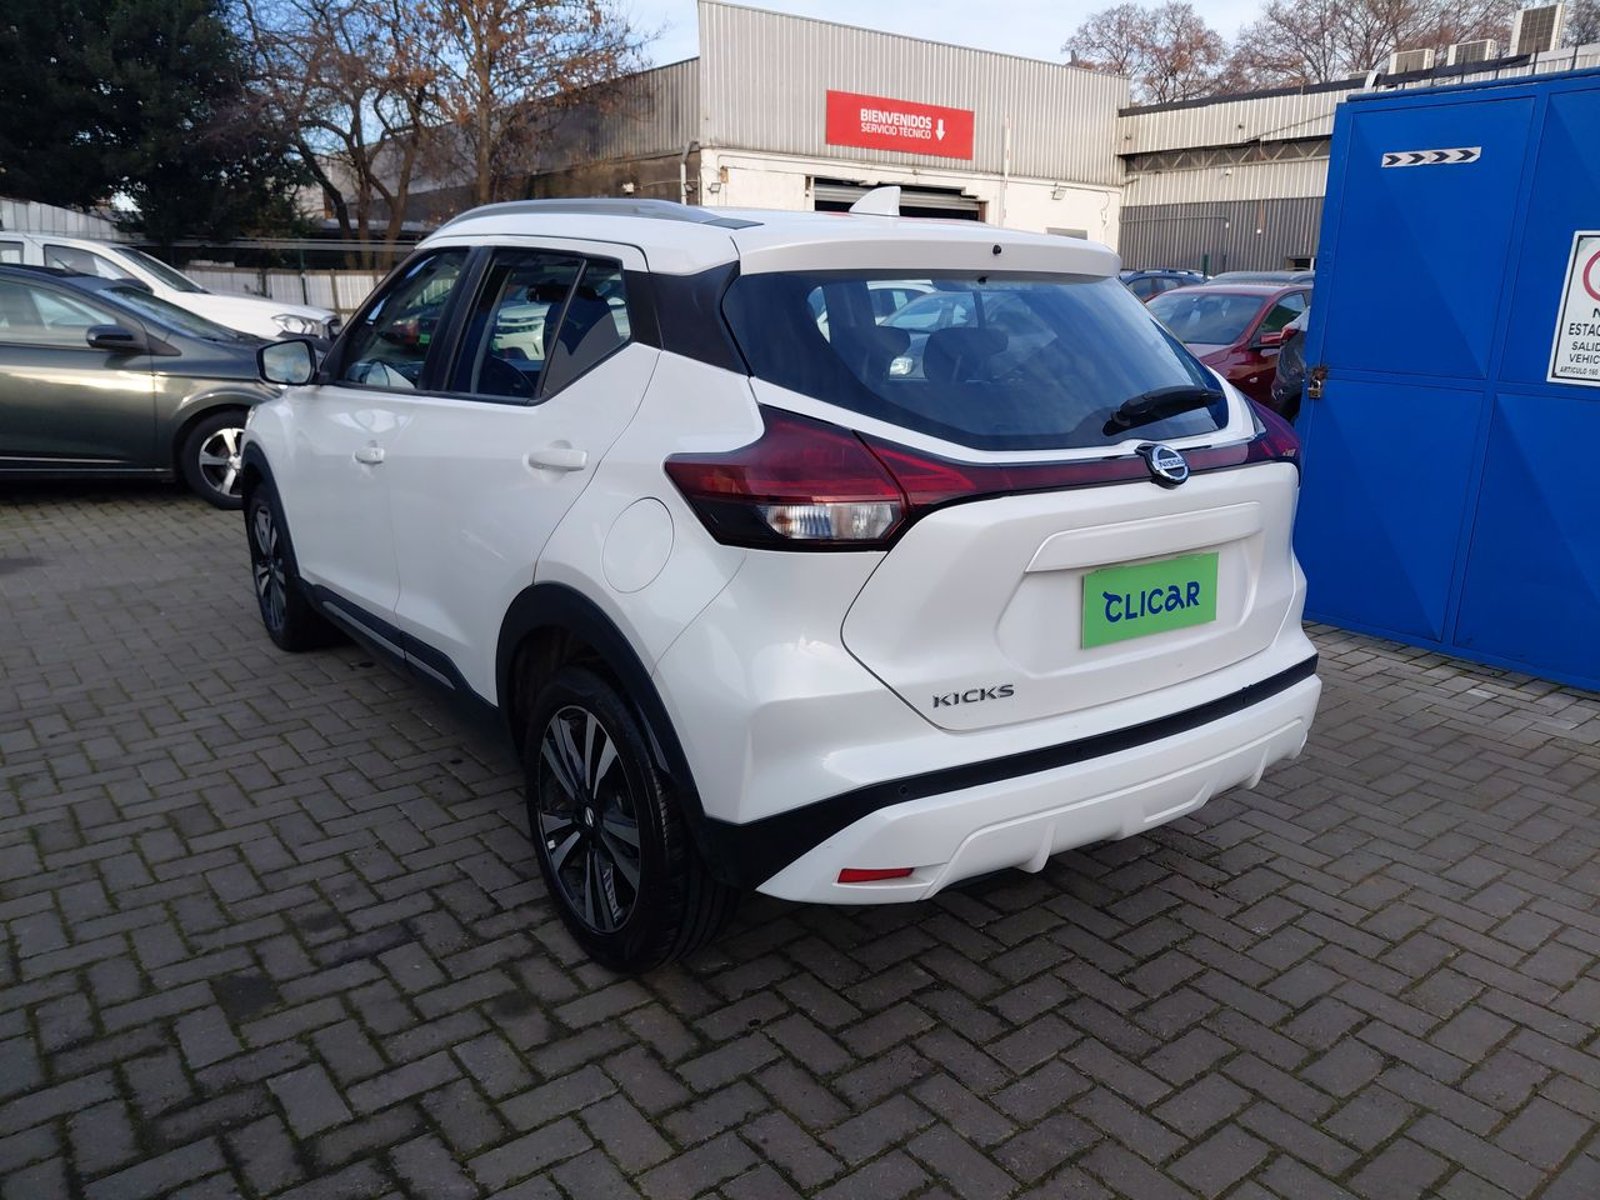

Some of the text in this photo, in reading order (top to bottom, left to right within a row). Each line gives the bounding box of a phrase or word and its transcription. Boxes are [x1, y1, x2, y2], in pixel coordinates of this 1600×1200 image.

[860, 108, 932, 130] BIENVENIDOS
[861, 122, 897, 136] SERVICIO
[1158, 458, 1185, 469] NISSAN
[932, 684, 1014, 708] KICKS
